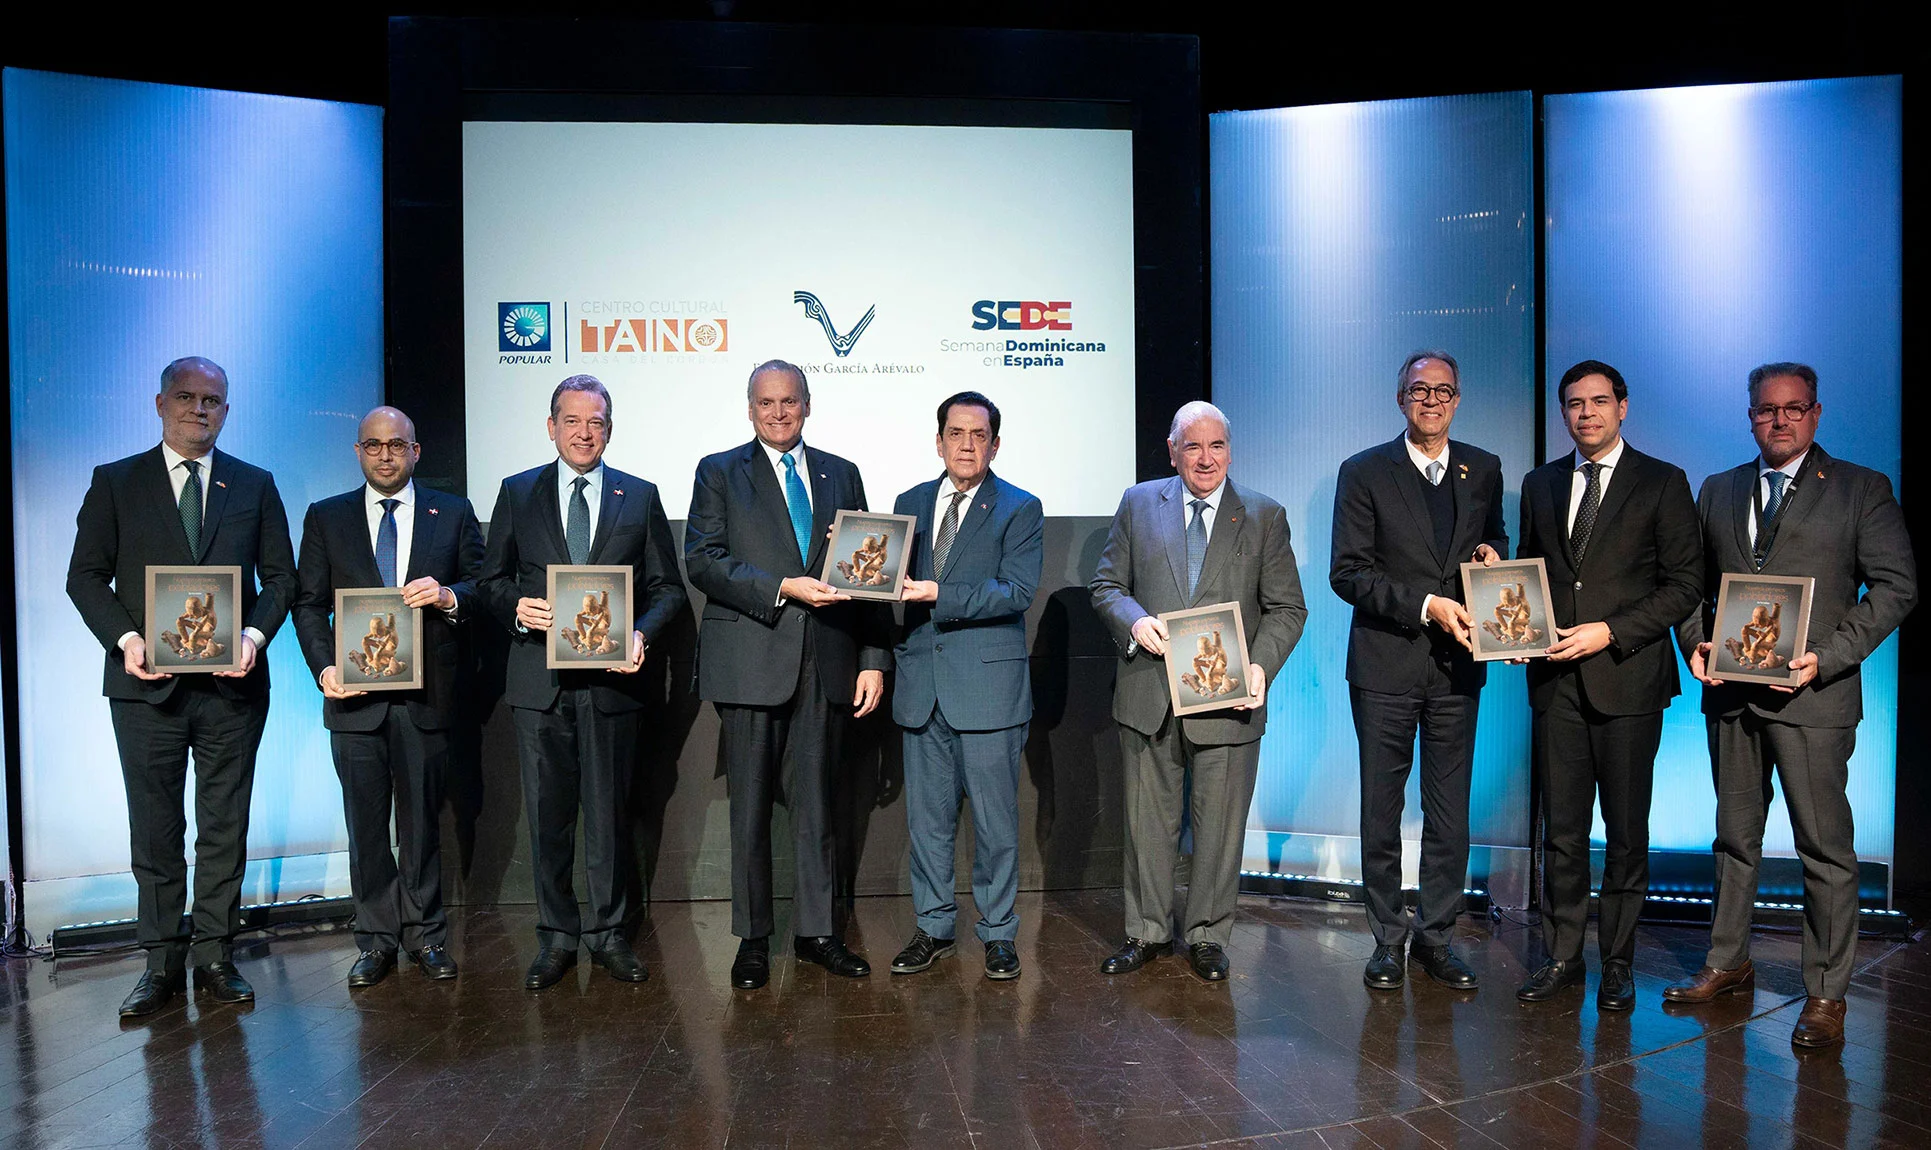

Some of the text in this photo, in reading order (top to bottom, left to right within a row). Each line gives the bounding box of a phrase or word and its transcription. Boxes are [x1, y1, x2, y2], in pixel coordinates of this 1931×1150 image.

[580, 300, 728, 314] CENTRO CULTURAL
[971, 299, 1073, 331] SEDE
[498, 354, 552, 365] POPULAR
